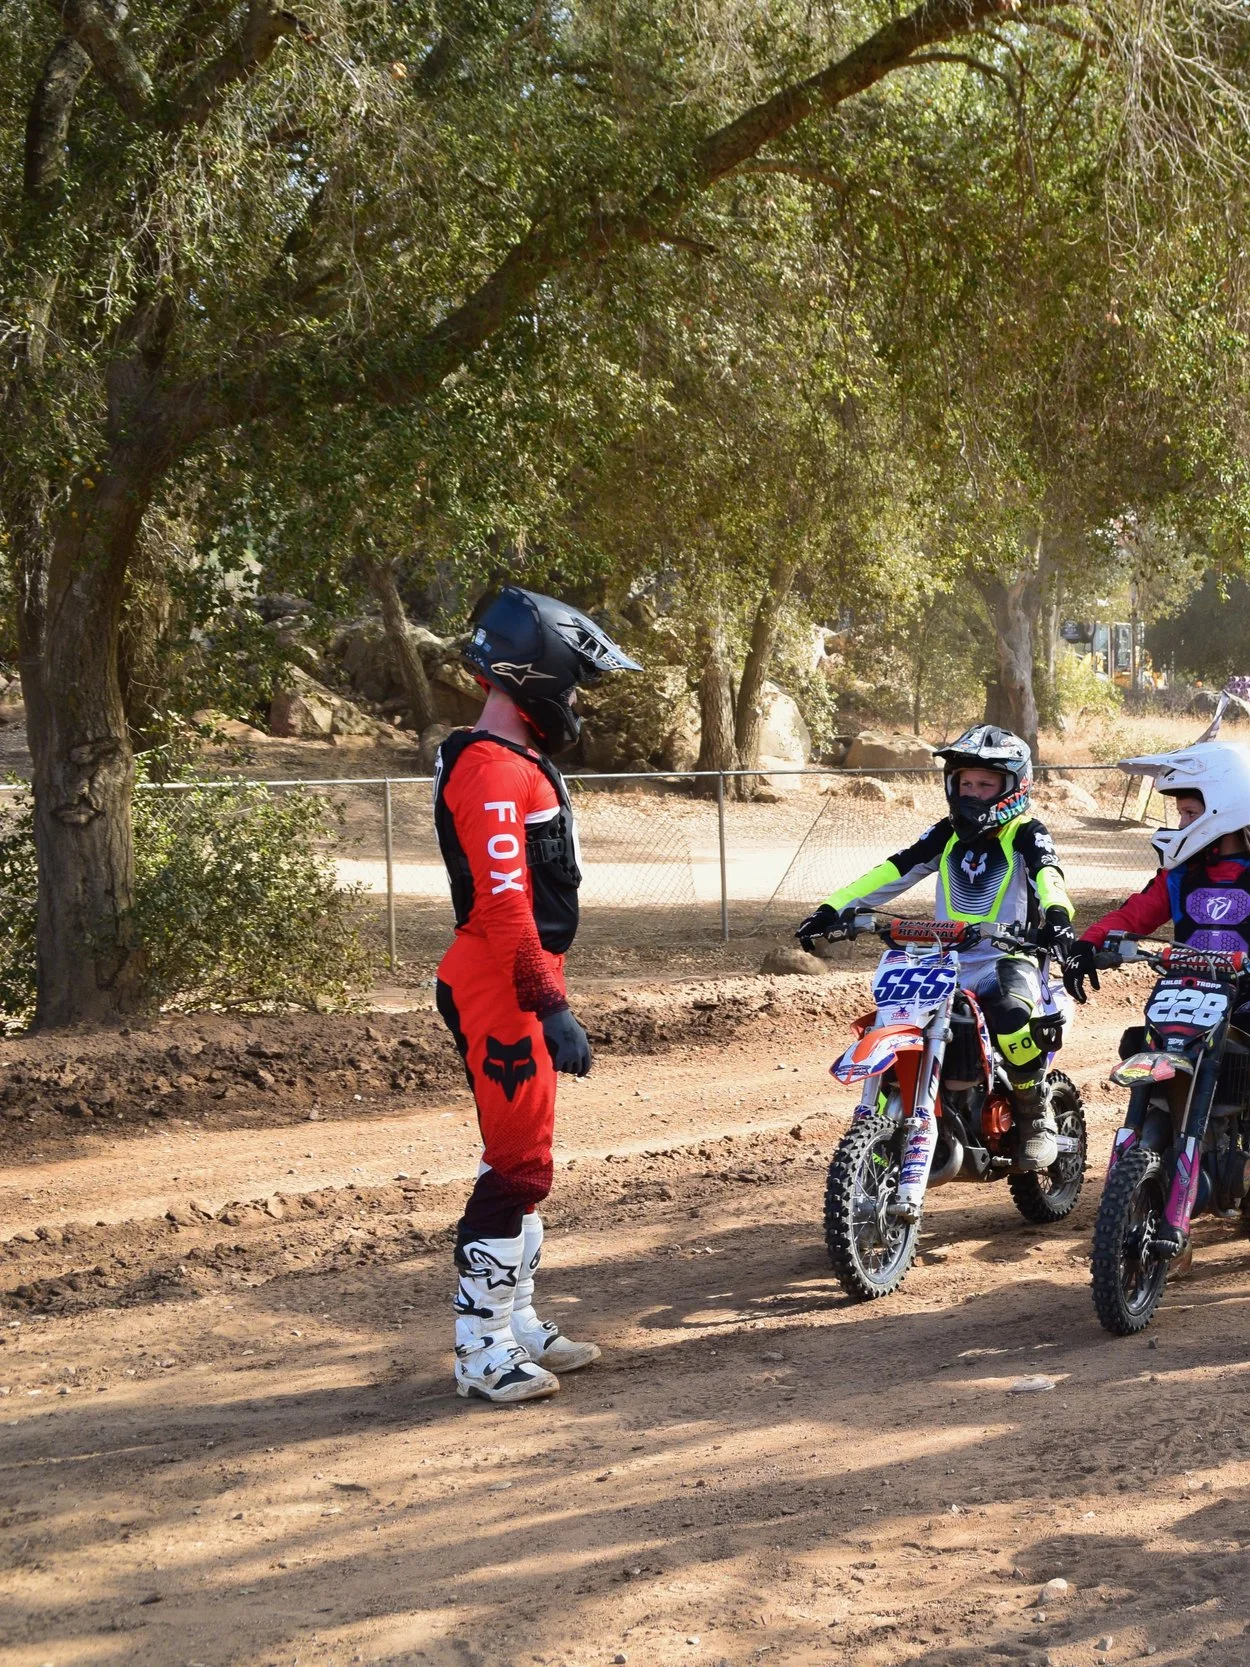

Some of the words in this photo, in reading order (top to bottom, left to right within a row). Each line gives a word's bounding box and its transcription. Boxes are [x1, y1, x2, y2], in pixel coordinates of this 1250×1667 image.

[484, 801, 524, 895] FOX
[898, 928, 958, 938] RENTHAL
[899, 920, 958, 929] RENTHAL
[1147, 988, 1229, 1027] 228
[1008, 1035, 1032, 1054] FO
